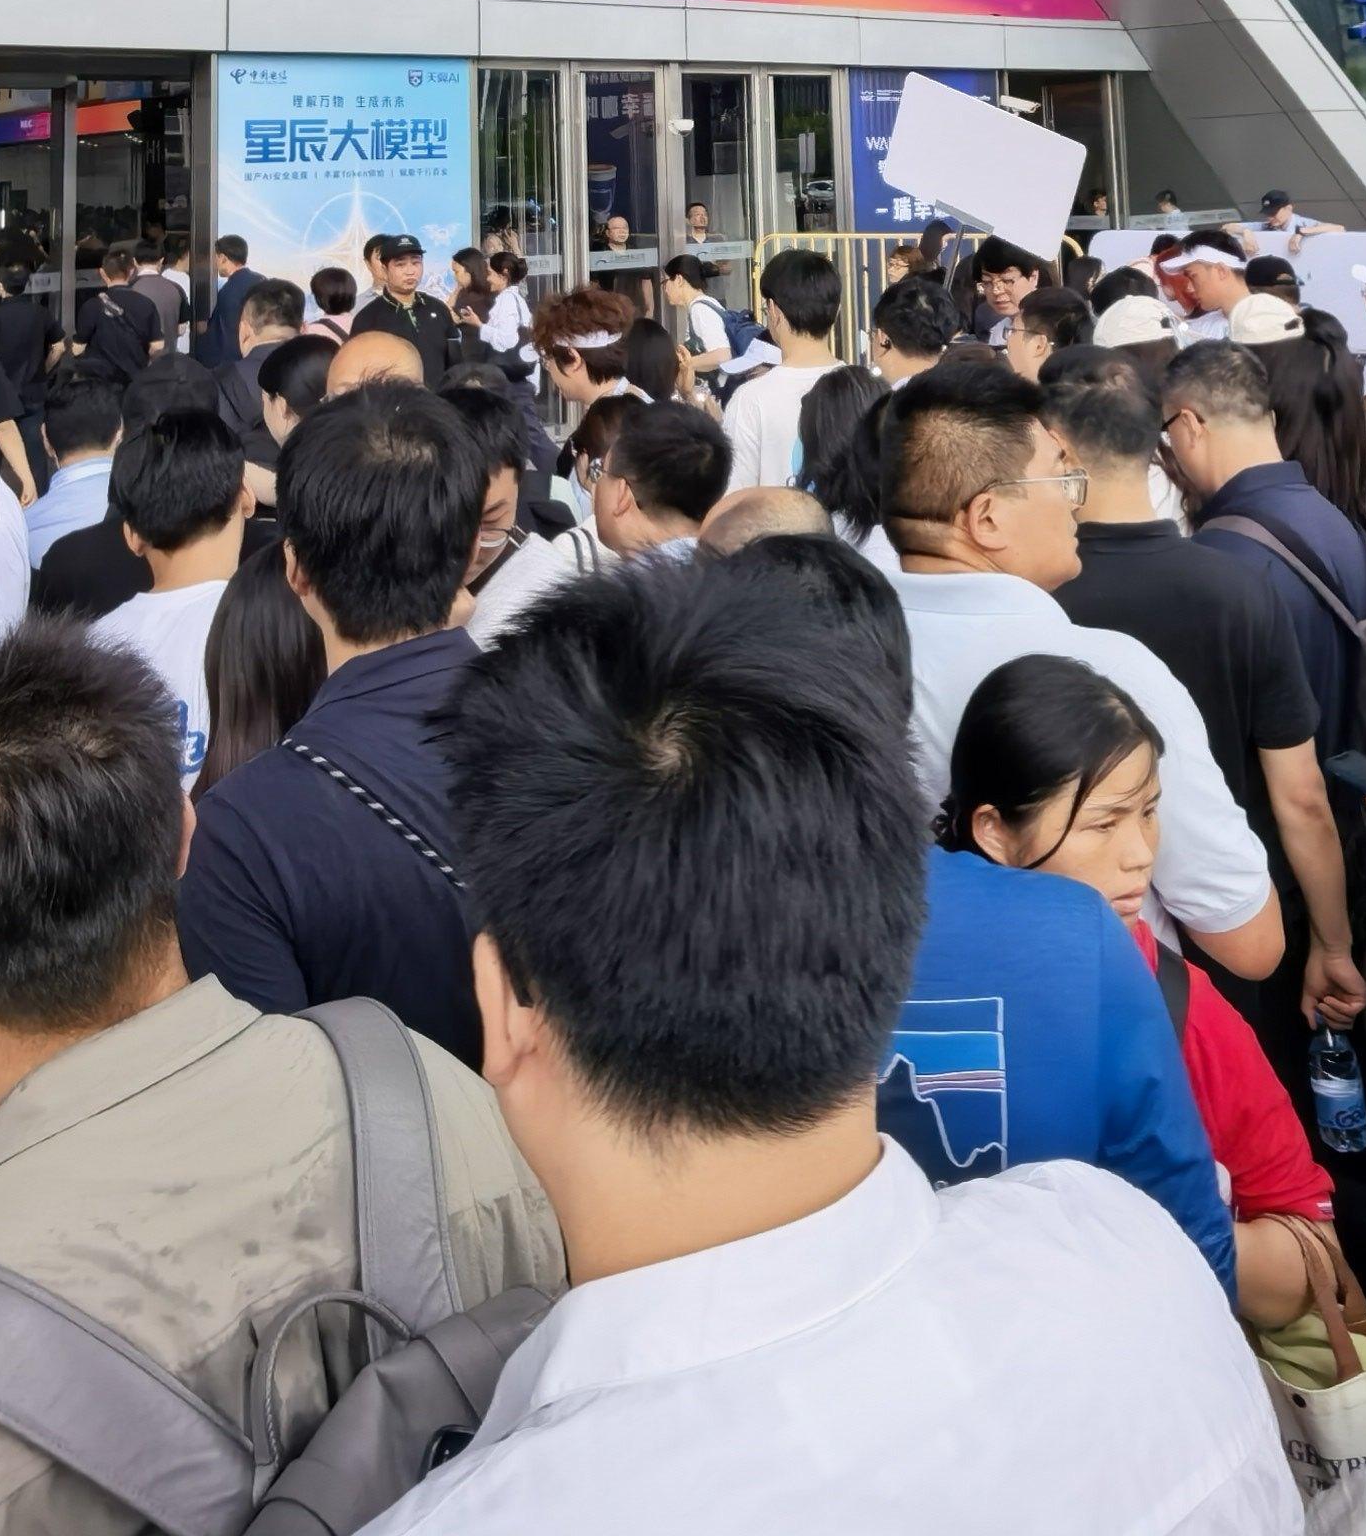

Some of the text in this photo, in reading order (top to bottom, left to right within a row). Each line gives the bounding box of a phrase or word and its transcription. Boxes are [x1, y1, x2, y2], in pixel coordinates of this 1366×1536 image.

[244, 119, 447, 163] 星辰大模型
